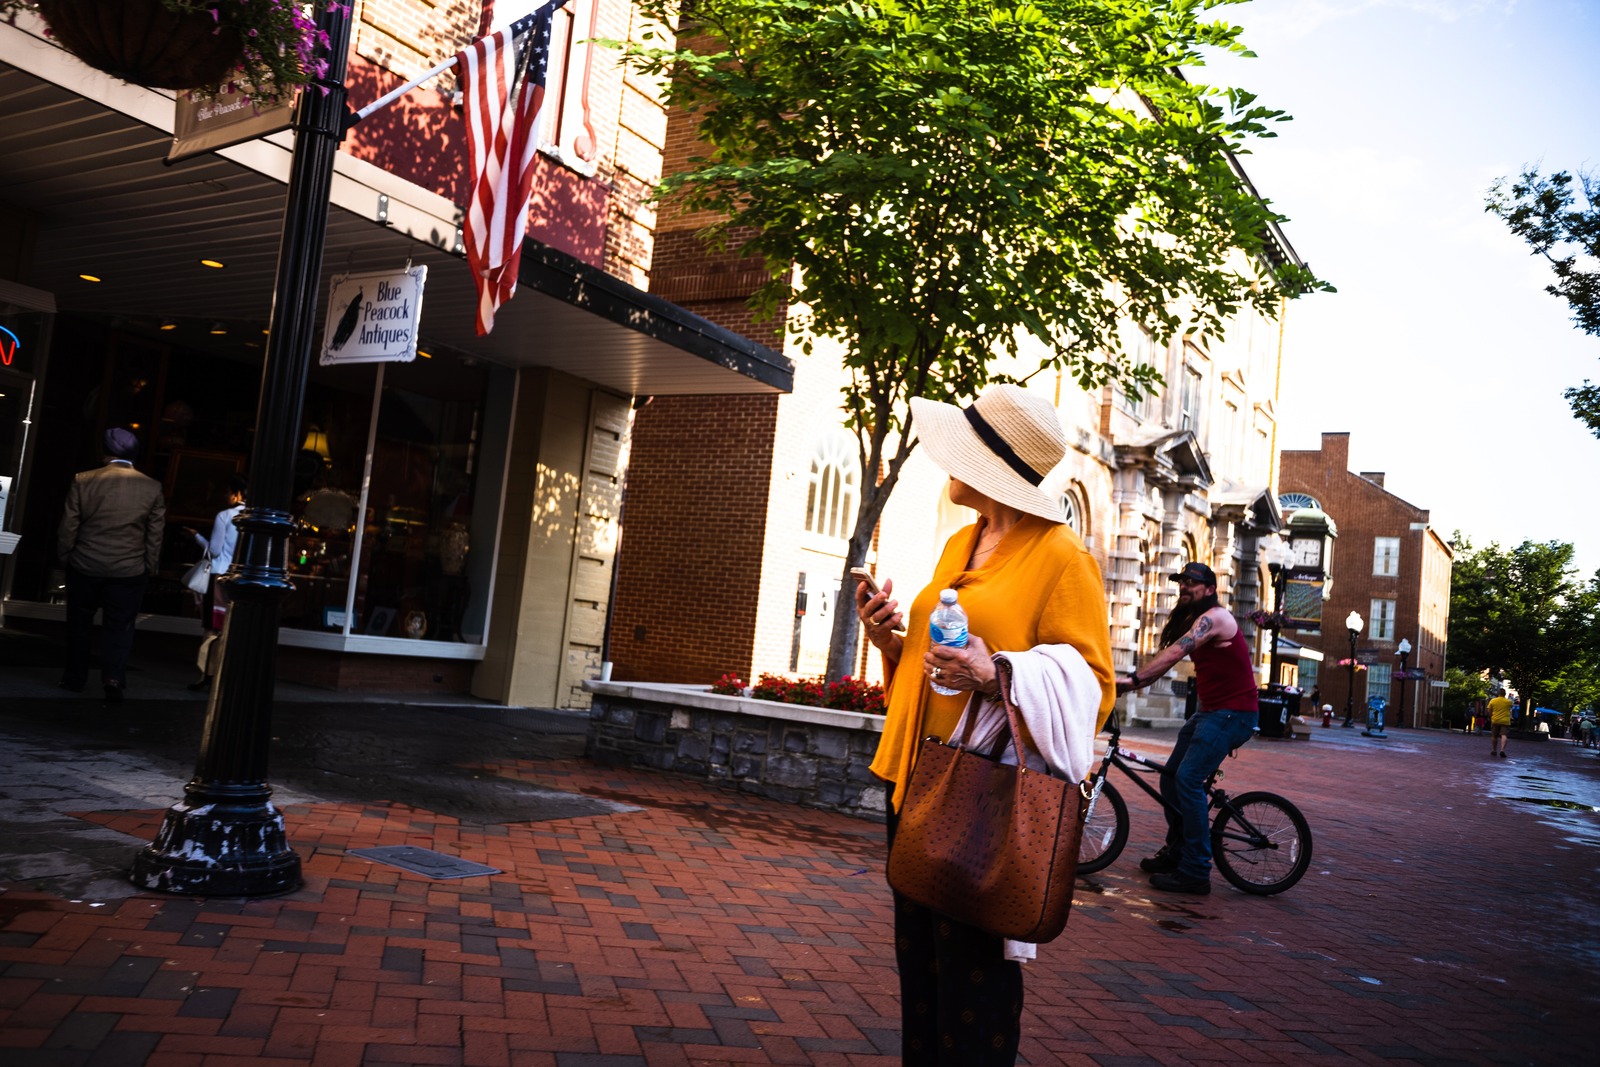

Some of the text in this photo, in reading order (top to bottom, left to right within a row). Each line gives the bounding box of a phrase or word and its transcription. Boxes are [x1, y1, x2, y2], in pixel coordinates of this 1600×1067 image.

[377, 281, 402, 302] Blue
[364, 298, 409, 322] Peacock
[359, 323, 410, 350] Antiques
